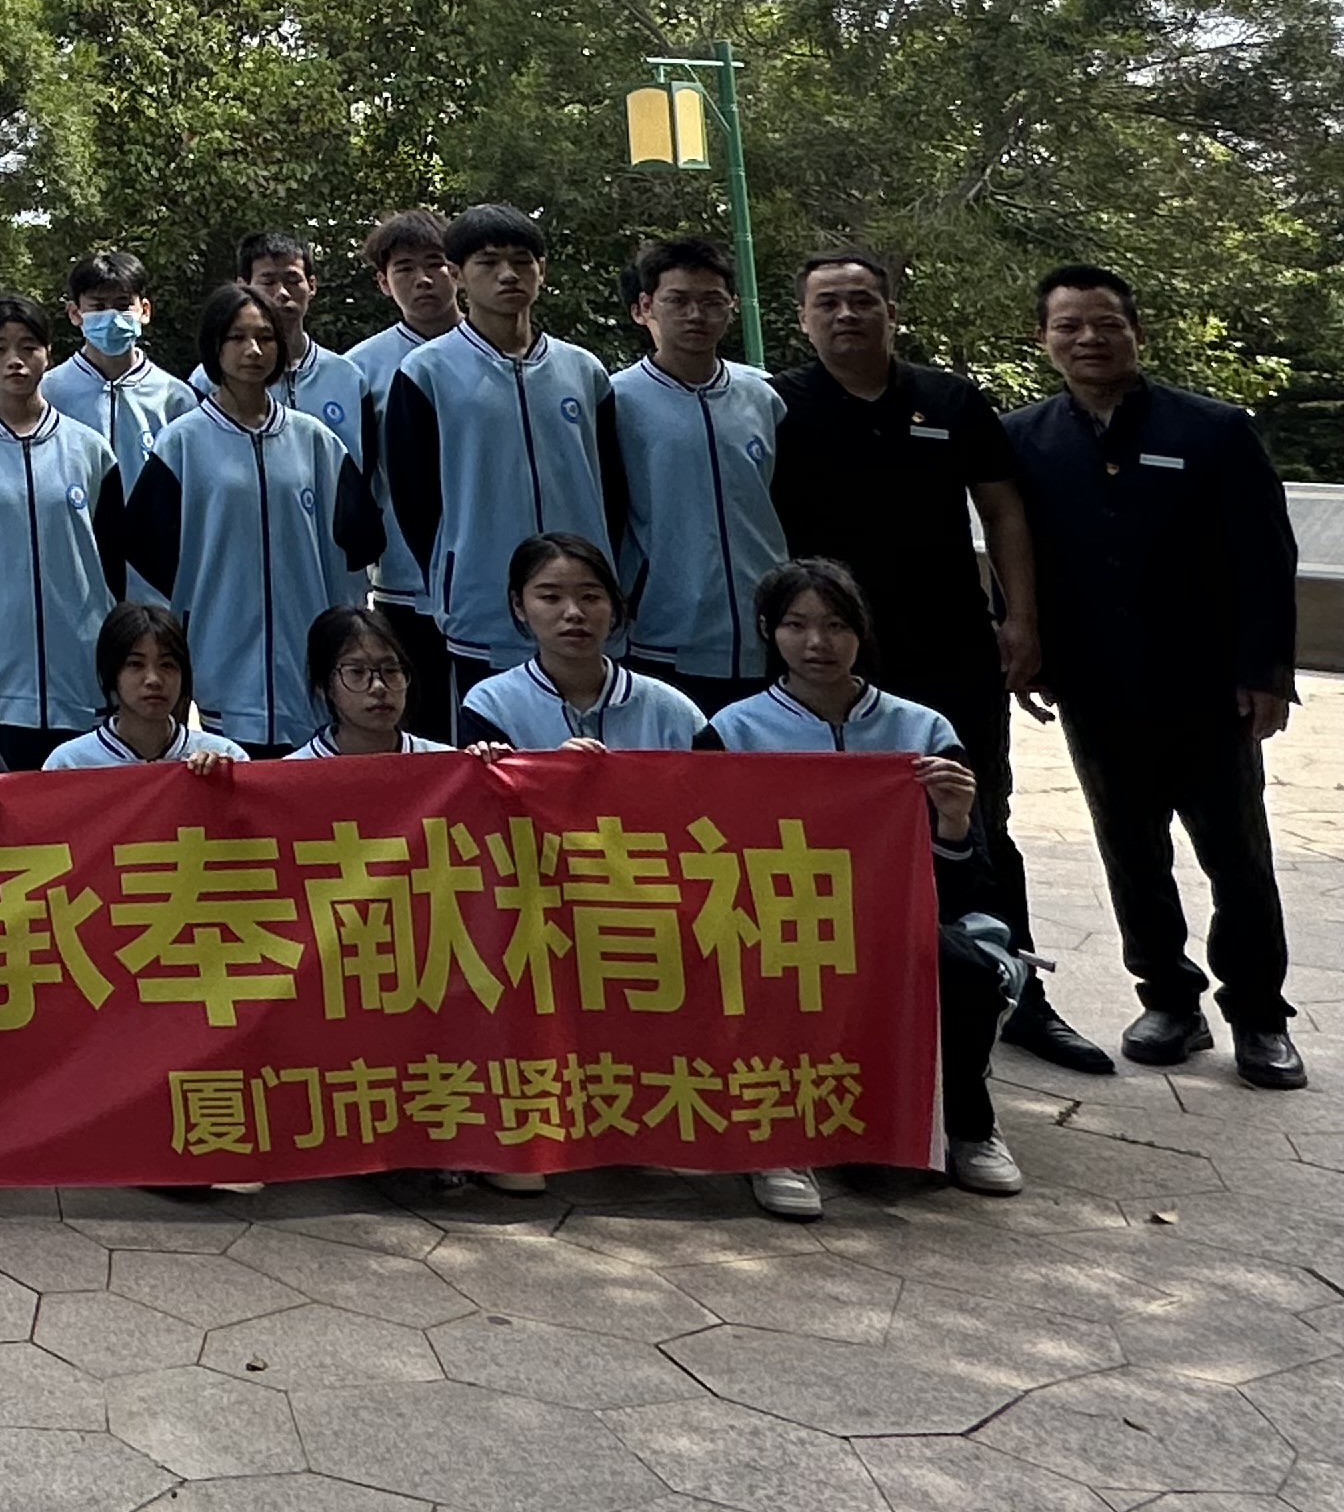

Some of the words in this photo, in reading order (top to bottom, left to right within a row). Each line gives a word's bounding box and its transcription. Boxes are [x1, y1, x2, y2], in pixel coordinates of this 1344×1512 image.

[168, 1051, 867, 1157] 厦门市孝贤技术学校
